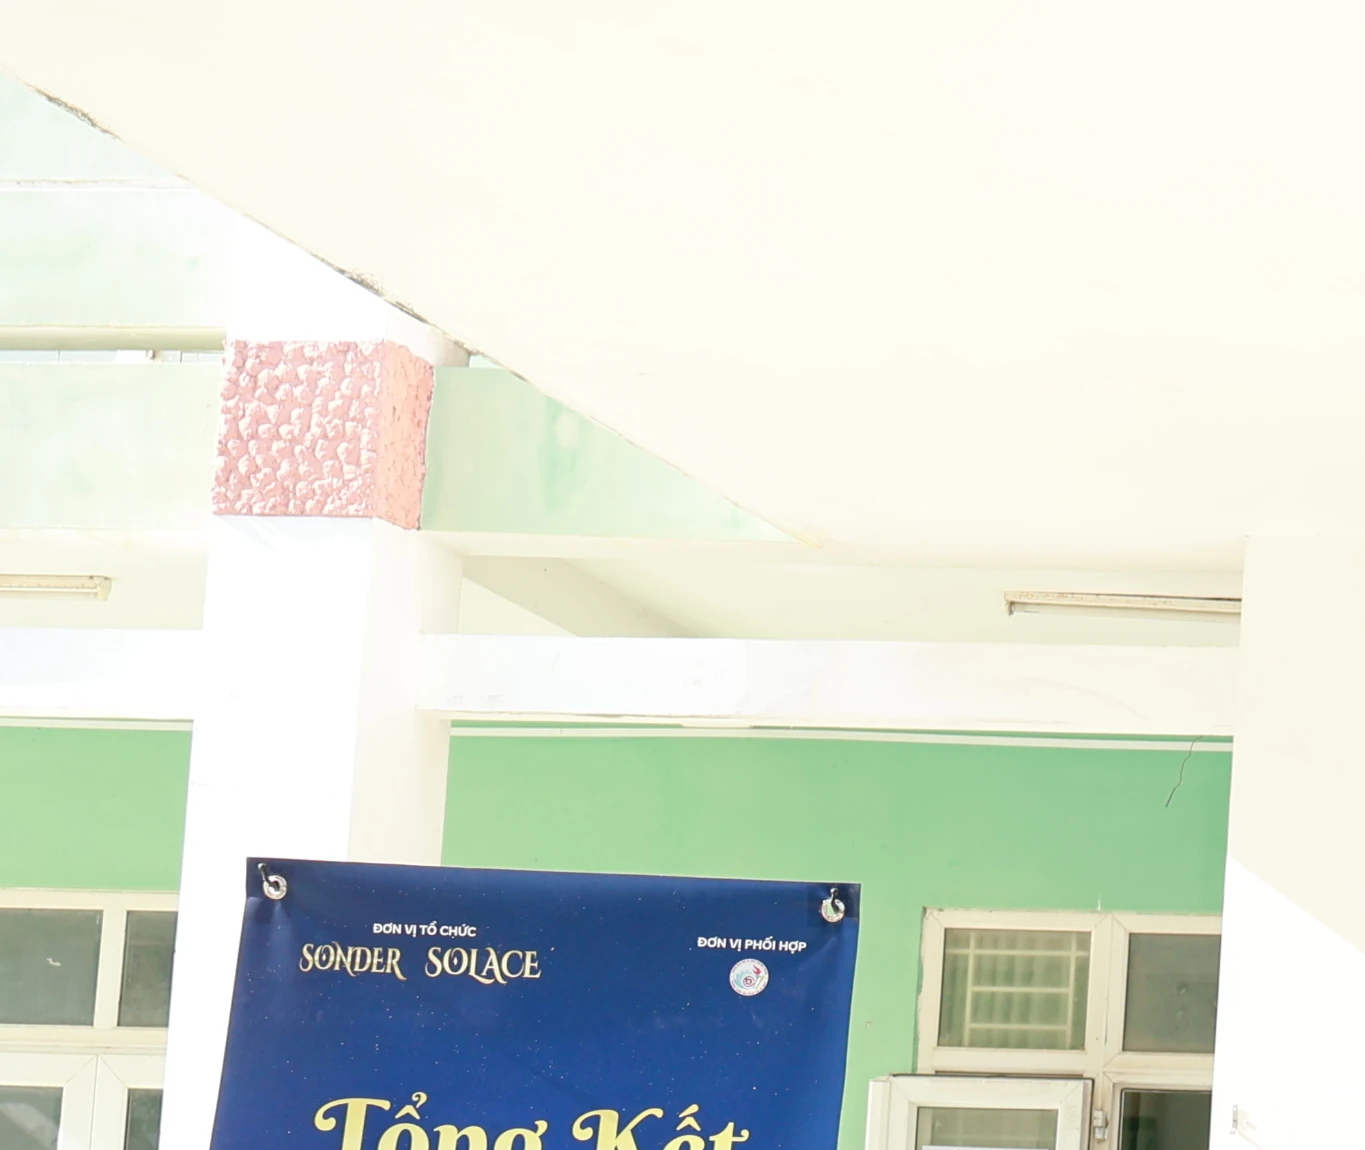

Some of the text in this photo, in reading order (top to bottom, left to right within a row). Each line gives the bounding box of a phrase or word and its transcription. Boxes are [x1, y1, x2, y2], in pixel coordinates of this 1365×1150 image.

[373, 920, 476, 938] ĐƠN VỊ TỔ CHỨC
[697, 935, 807, 954] ĐƠN VỊ PHỐI HỢP
[299, 940, 542, 985] SONDER SOLACE
